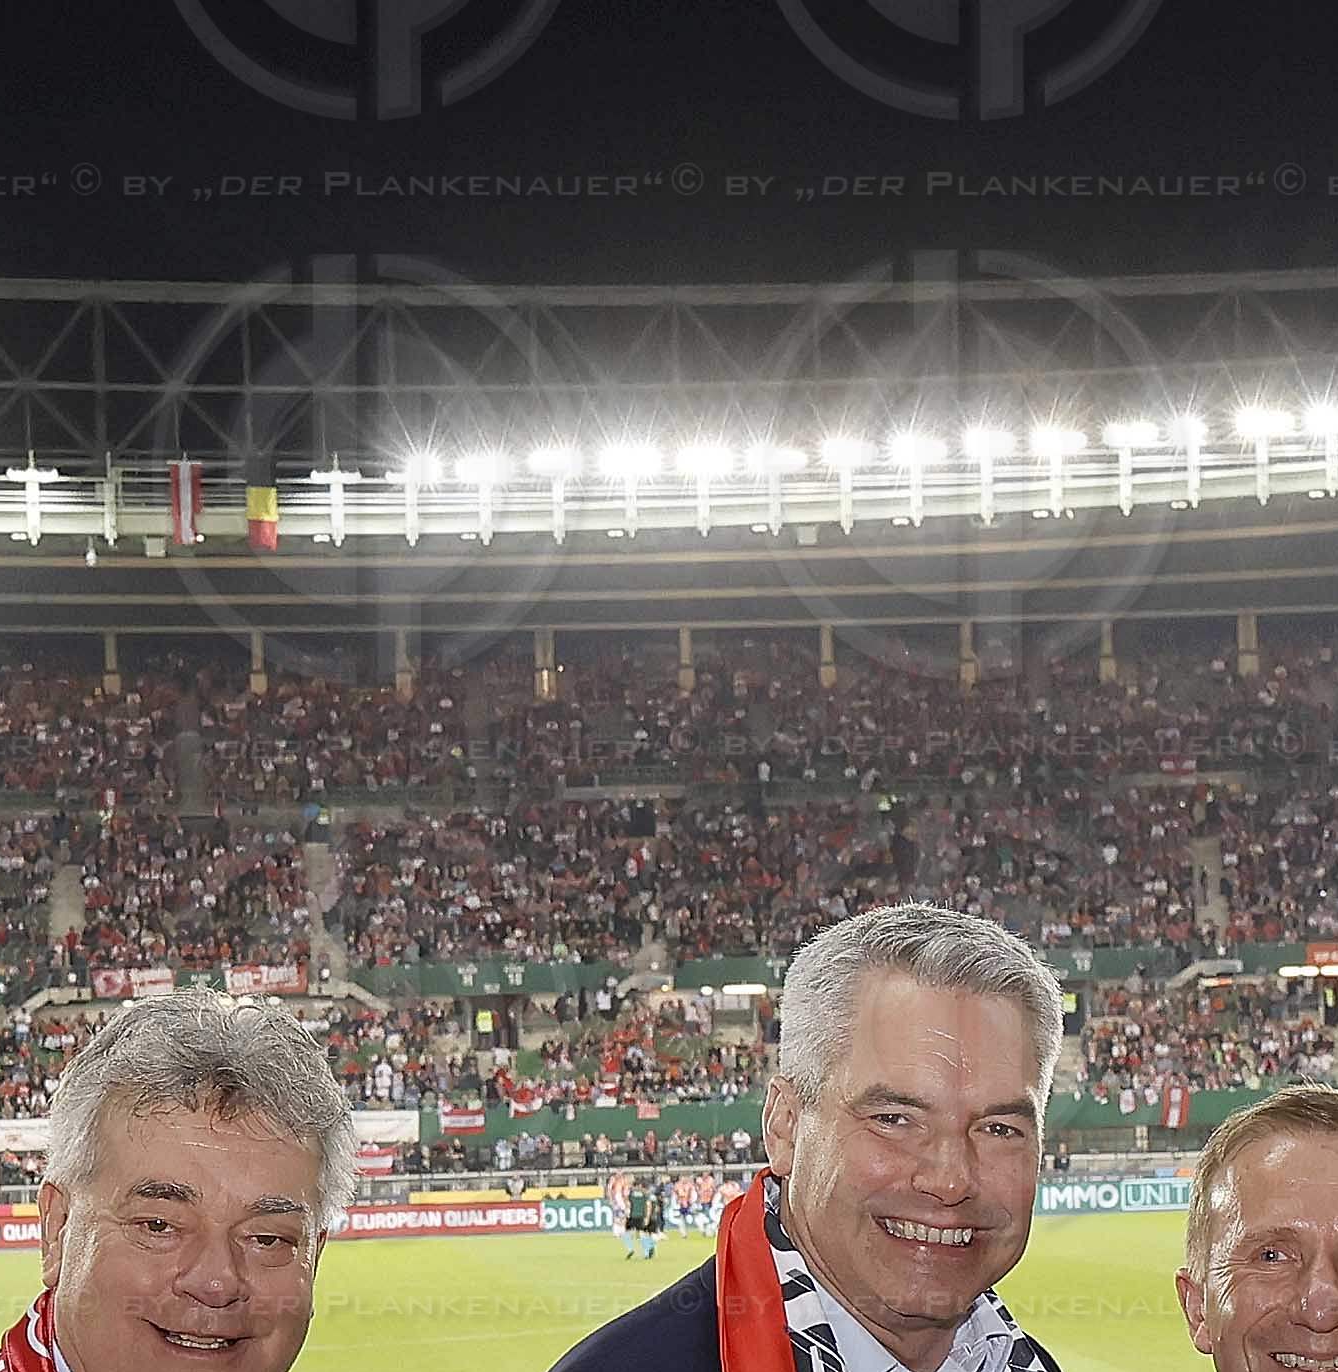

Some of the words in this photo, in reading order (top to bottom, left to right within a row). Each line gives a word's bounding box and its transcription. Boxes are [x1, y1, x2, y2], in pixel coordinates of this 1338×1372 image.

[1041, 1184, 1120, 1211] IMMO
[1126, 1183, 1189, 1206] UNIT
[352, 1211, 442, 1231] EUROPEAN
[444, 1206, 538, 1227] QUALIFIERS
